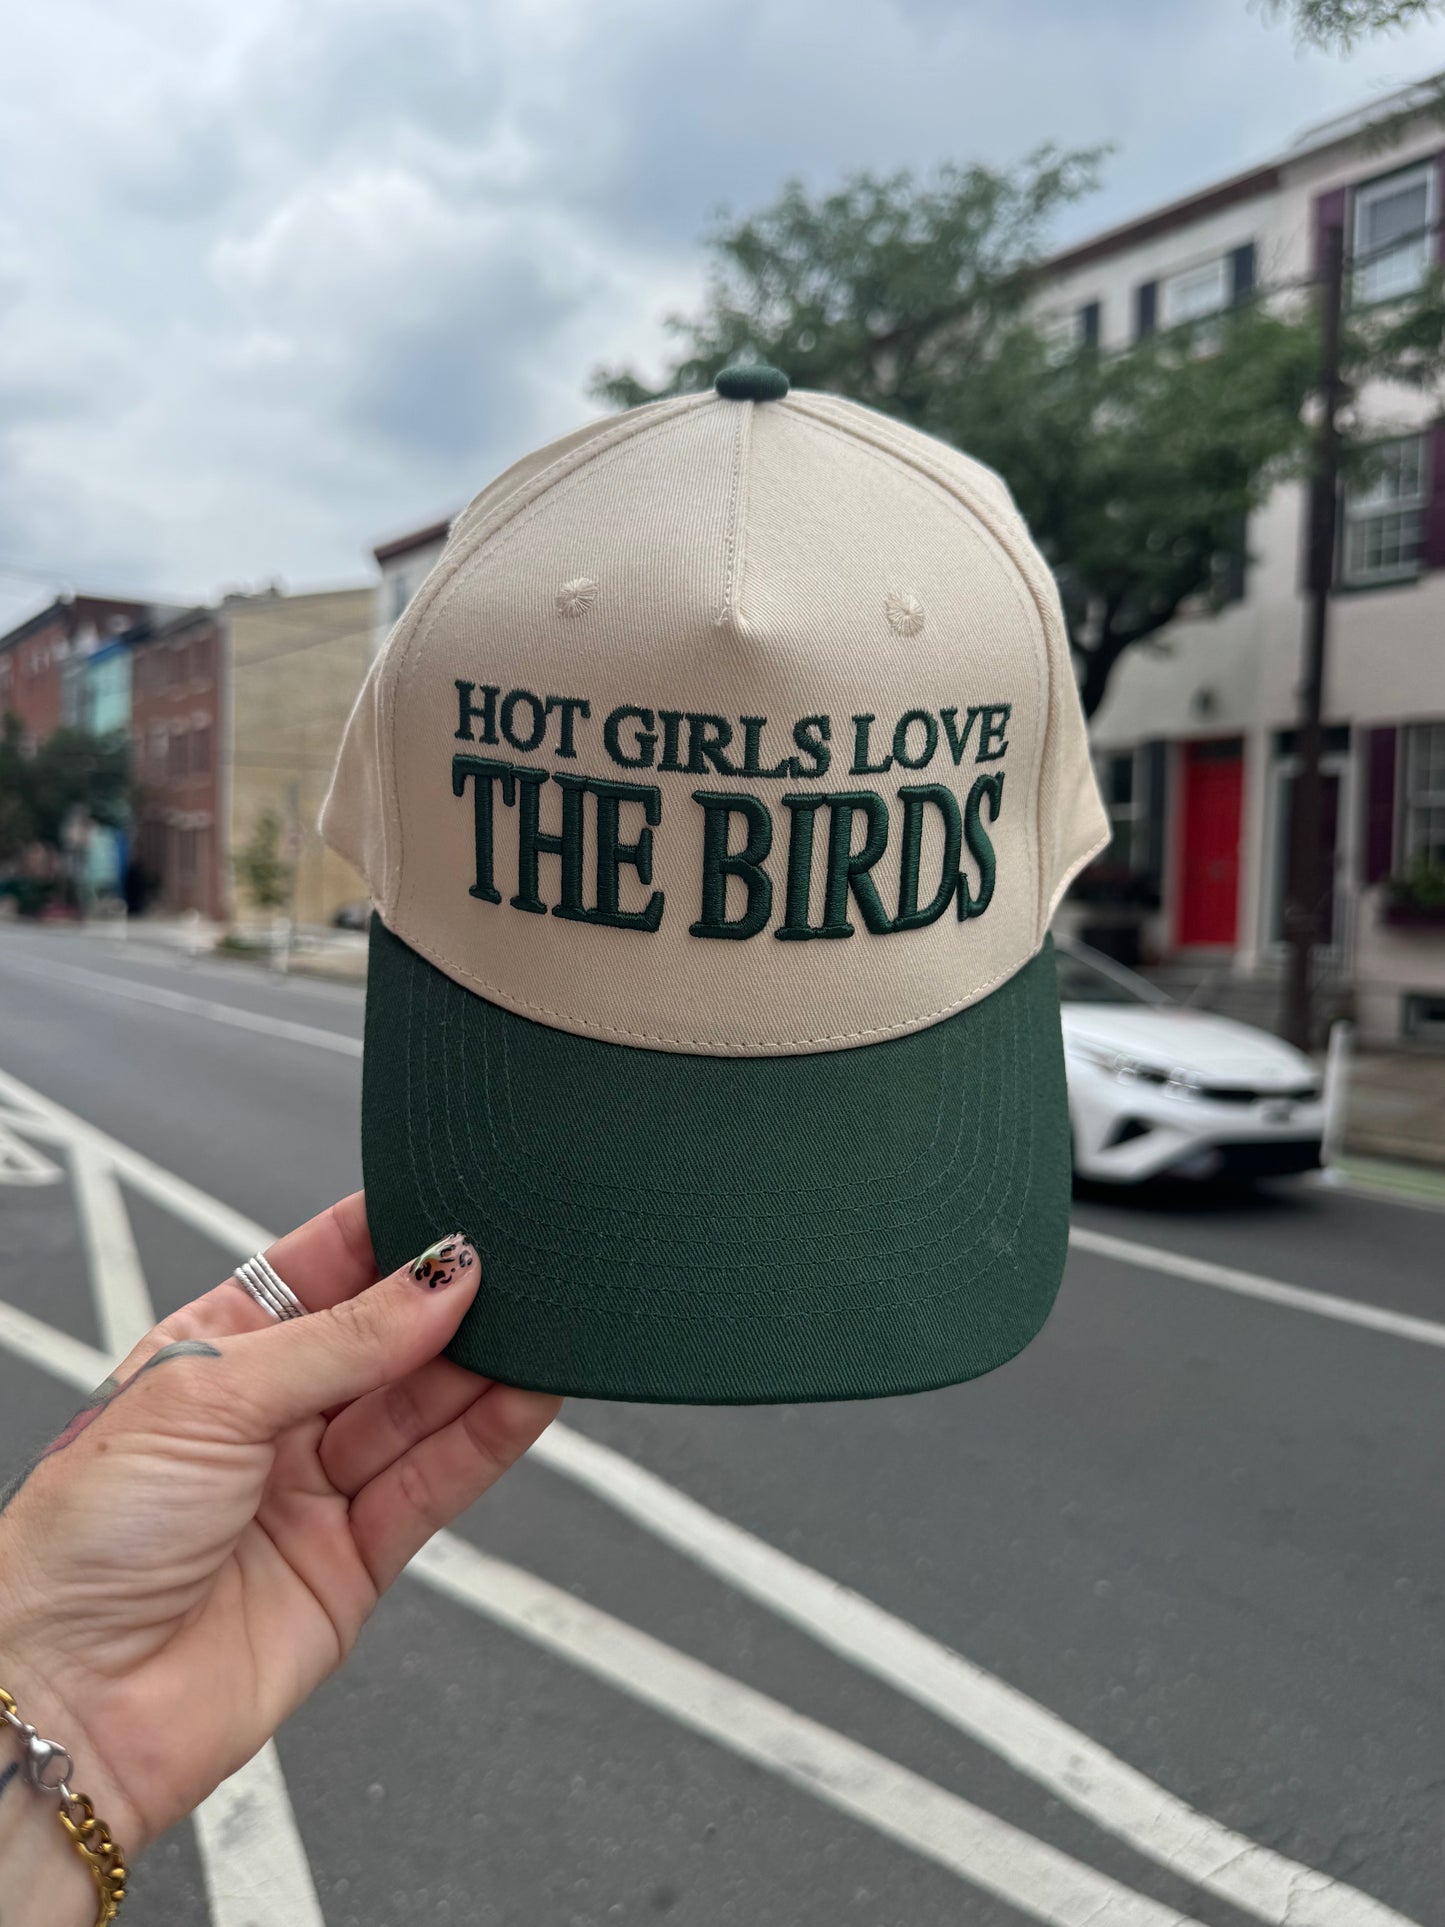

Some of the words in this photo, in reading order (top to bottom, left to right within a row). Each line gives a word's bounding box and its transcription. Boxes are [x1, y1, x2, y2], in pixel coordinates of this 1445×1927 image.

[453, 678, 592, 760] HOT
[603, 703, 832, 781] GIRLS
[848, 703, 1012, 777] LOVE
[452, 752, 666, 935] THE
[688, 771, 1006, 944] BIRDS
